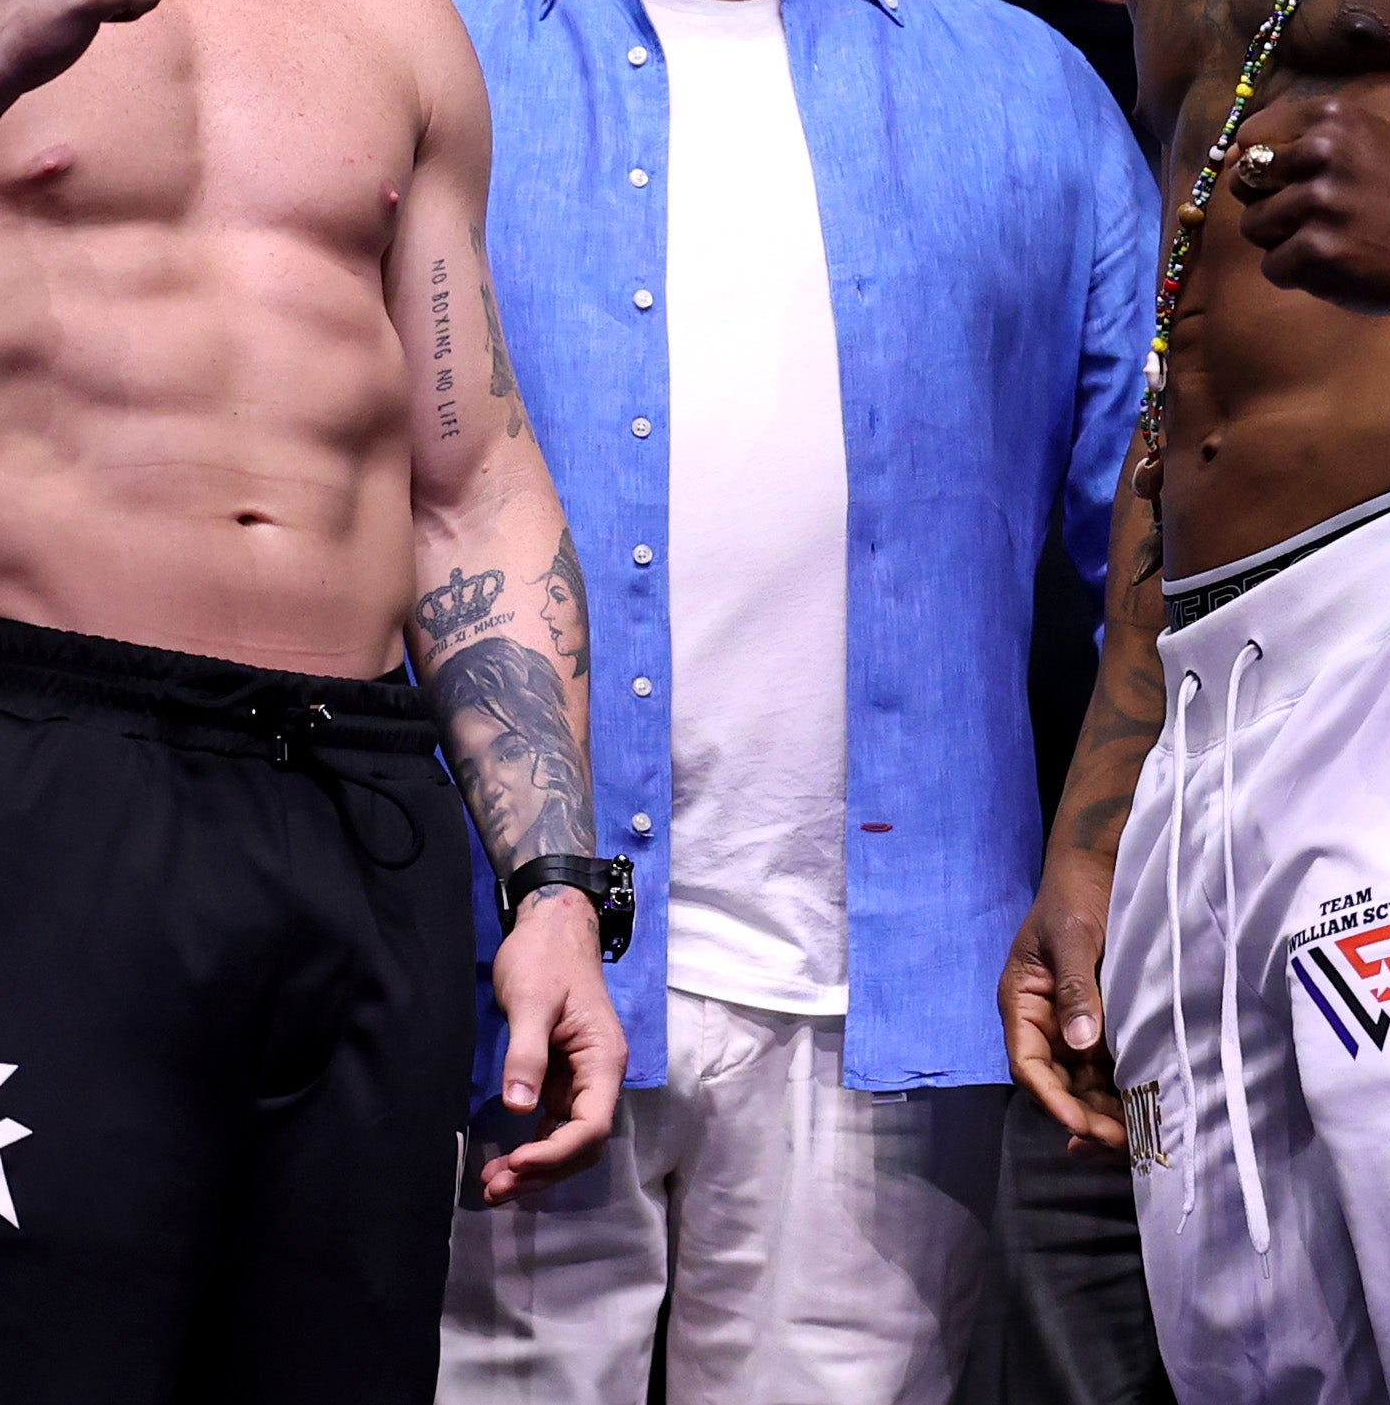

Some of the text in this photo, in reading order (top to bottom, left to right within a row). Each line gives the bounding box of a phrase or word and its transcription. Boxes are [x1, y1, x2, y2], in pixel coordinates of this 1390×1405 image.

[431, 258, 460, 440] NO BOXING NO LIFE
[1319, 887, 1372, 916] TEAM
[1288, 911, 1359, 954] WILLIAM
